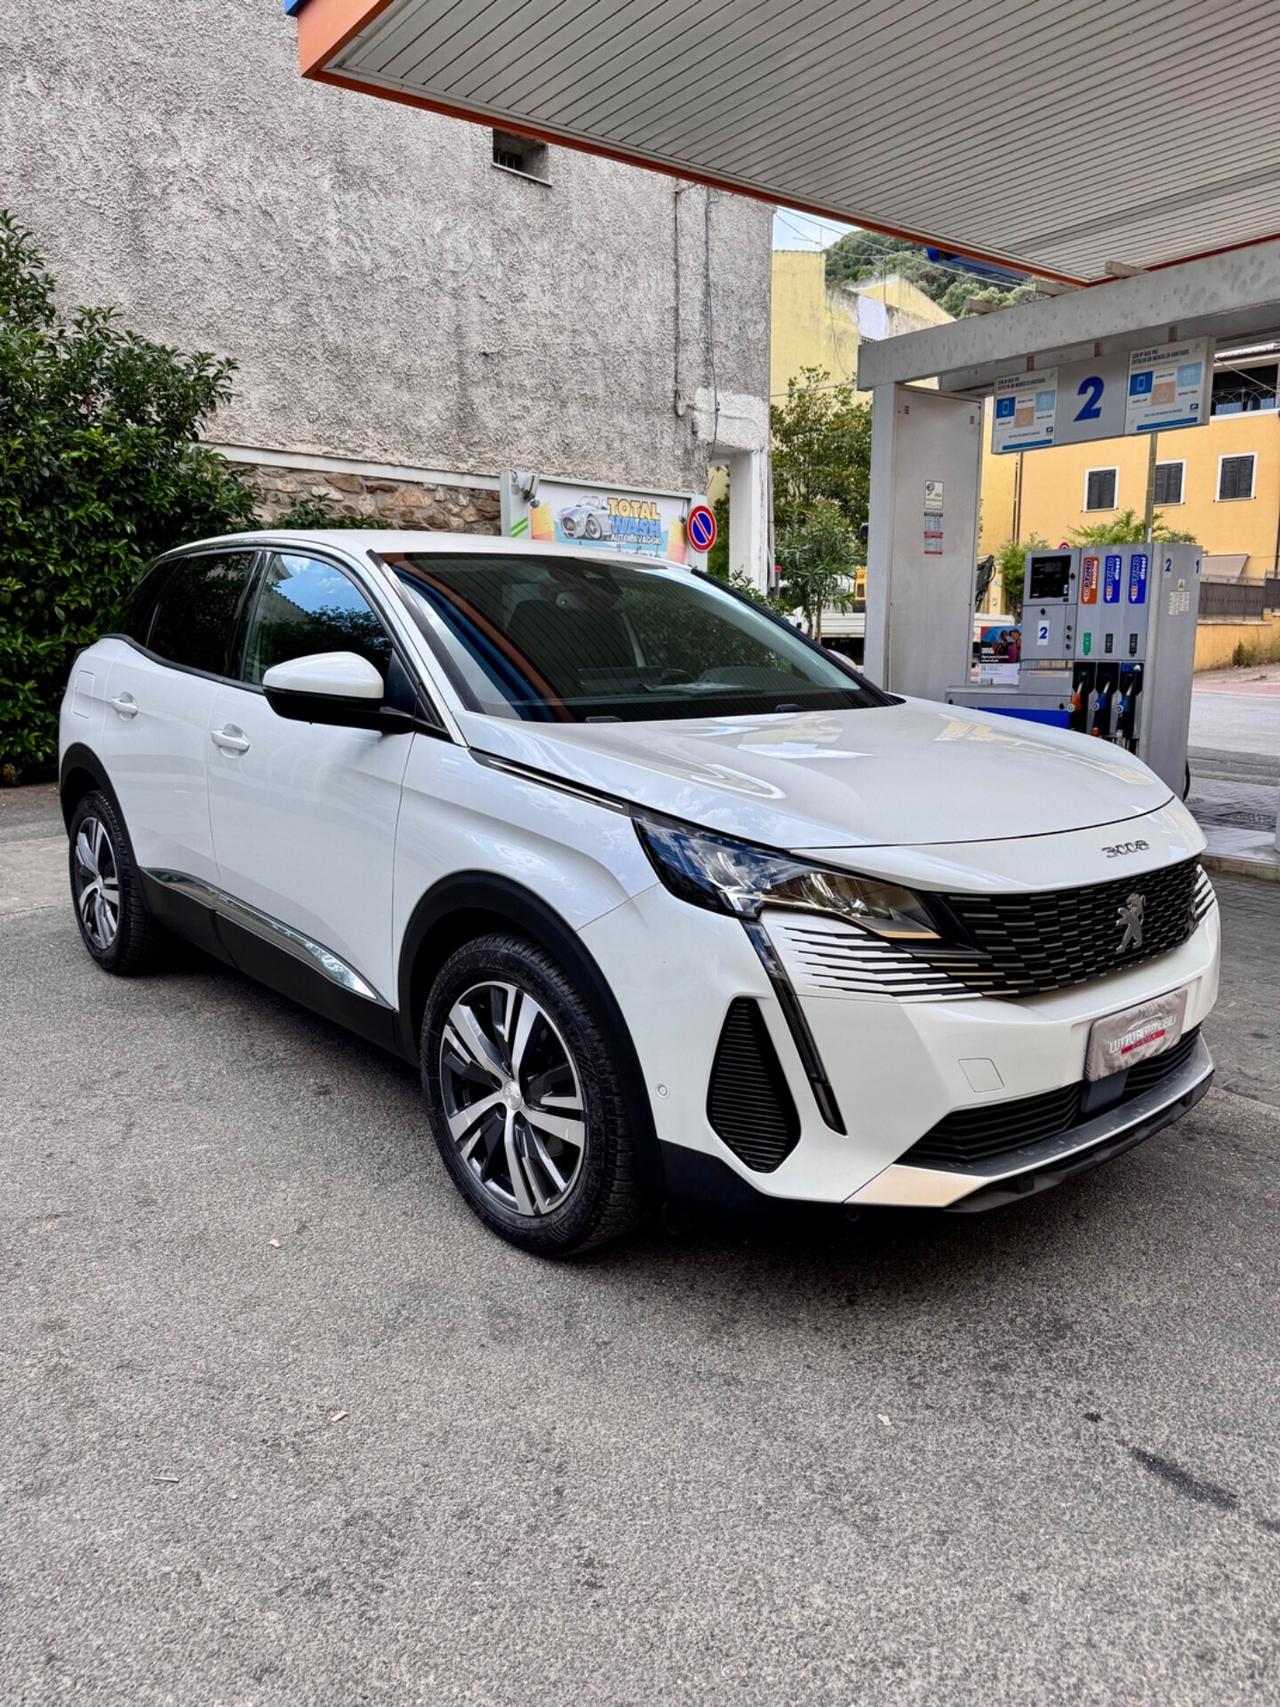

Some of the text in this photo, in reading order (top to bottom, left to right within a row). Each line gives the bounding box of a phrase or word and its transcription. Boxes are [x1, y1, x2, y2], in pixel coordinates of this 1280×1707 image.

[1073, 376, 1105, 422] 2
[607, 497, 661, 520] TOTAL
[608, 515, 661, 537] WASH
[1165, 558, 1172, 572] 2
[1195, 559, 1200, 574] 1
[1039, 626, 1048, 639] 2
[1101, 839, 1150, 858] 3008
